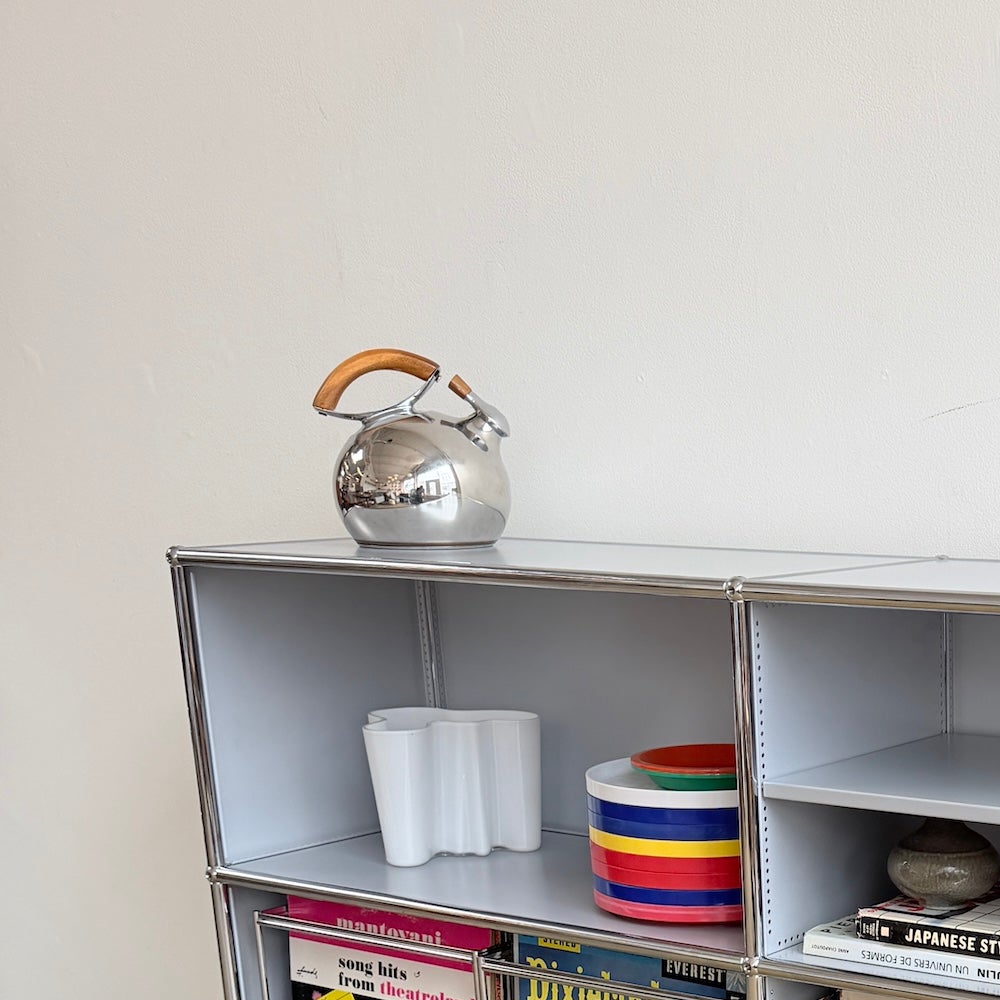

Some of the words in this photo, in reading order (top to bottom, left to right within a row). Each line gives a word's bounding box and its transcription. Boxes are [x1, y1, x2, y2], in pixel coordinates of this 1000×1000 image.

[337, 917, 442, 945] mantovani
[905, 928, 976, 951] JAPANESE
[861, 950, 897, 964] FORMES
[900, 955, 912, 966] DE
[914, 958, 953, 974] UNIVERS
[338, 957, 374, 977] song
[378, 961, 407, 981] hits
[666, 959, 725, 983] EVEREST
[955, 964, 969, 975] UN
[338, 972, 375, 992] from
